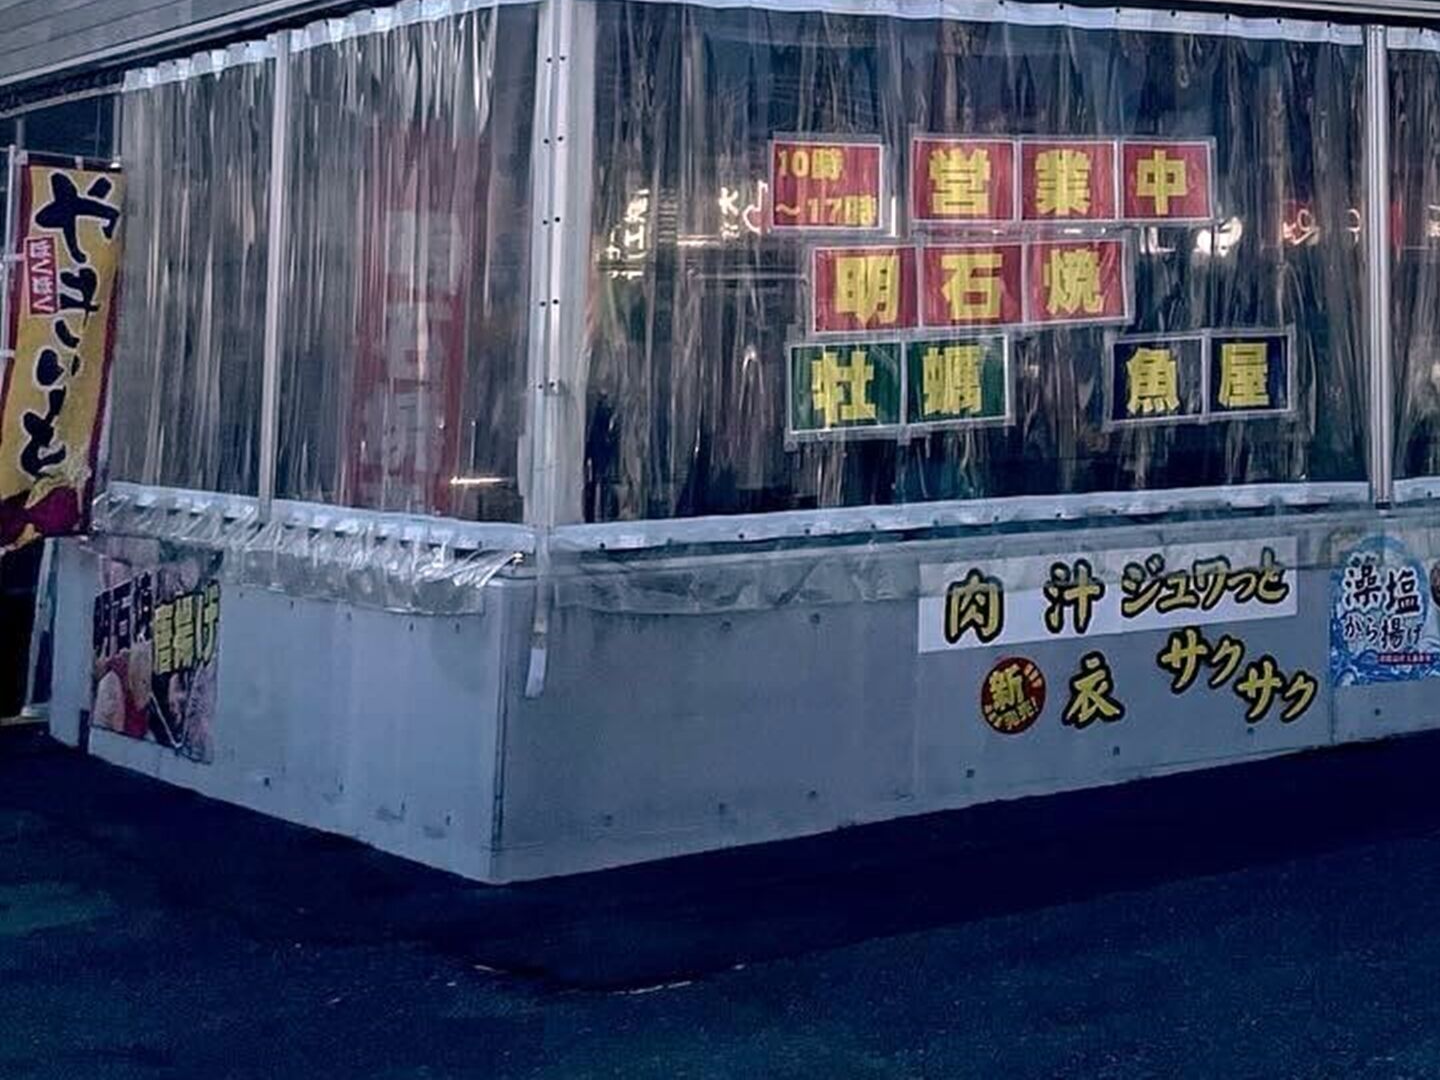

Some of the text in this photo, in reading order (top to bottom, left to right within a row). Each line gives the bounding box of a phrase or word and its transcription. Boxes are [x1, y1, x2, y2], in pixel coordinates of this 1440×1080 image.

[777, 147, 843, 181] 10時
[928, 147, 1187, 217] 営業中
[834, 248, 1103, 325] 明石焼
[811, 344, 985, 426] 牡蠣
[1124, 341, 1270, 417] 魚屋
[1343, 553, 1422, 616] 藻塩
[1344, 613, 1424, 651] から揚げ
